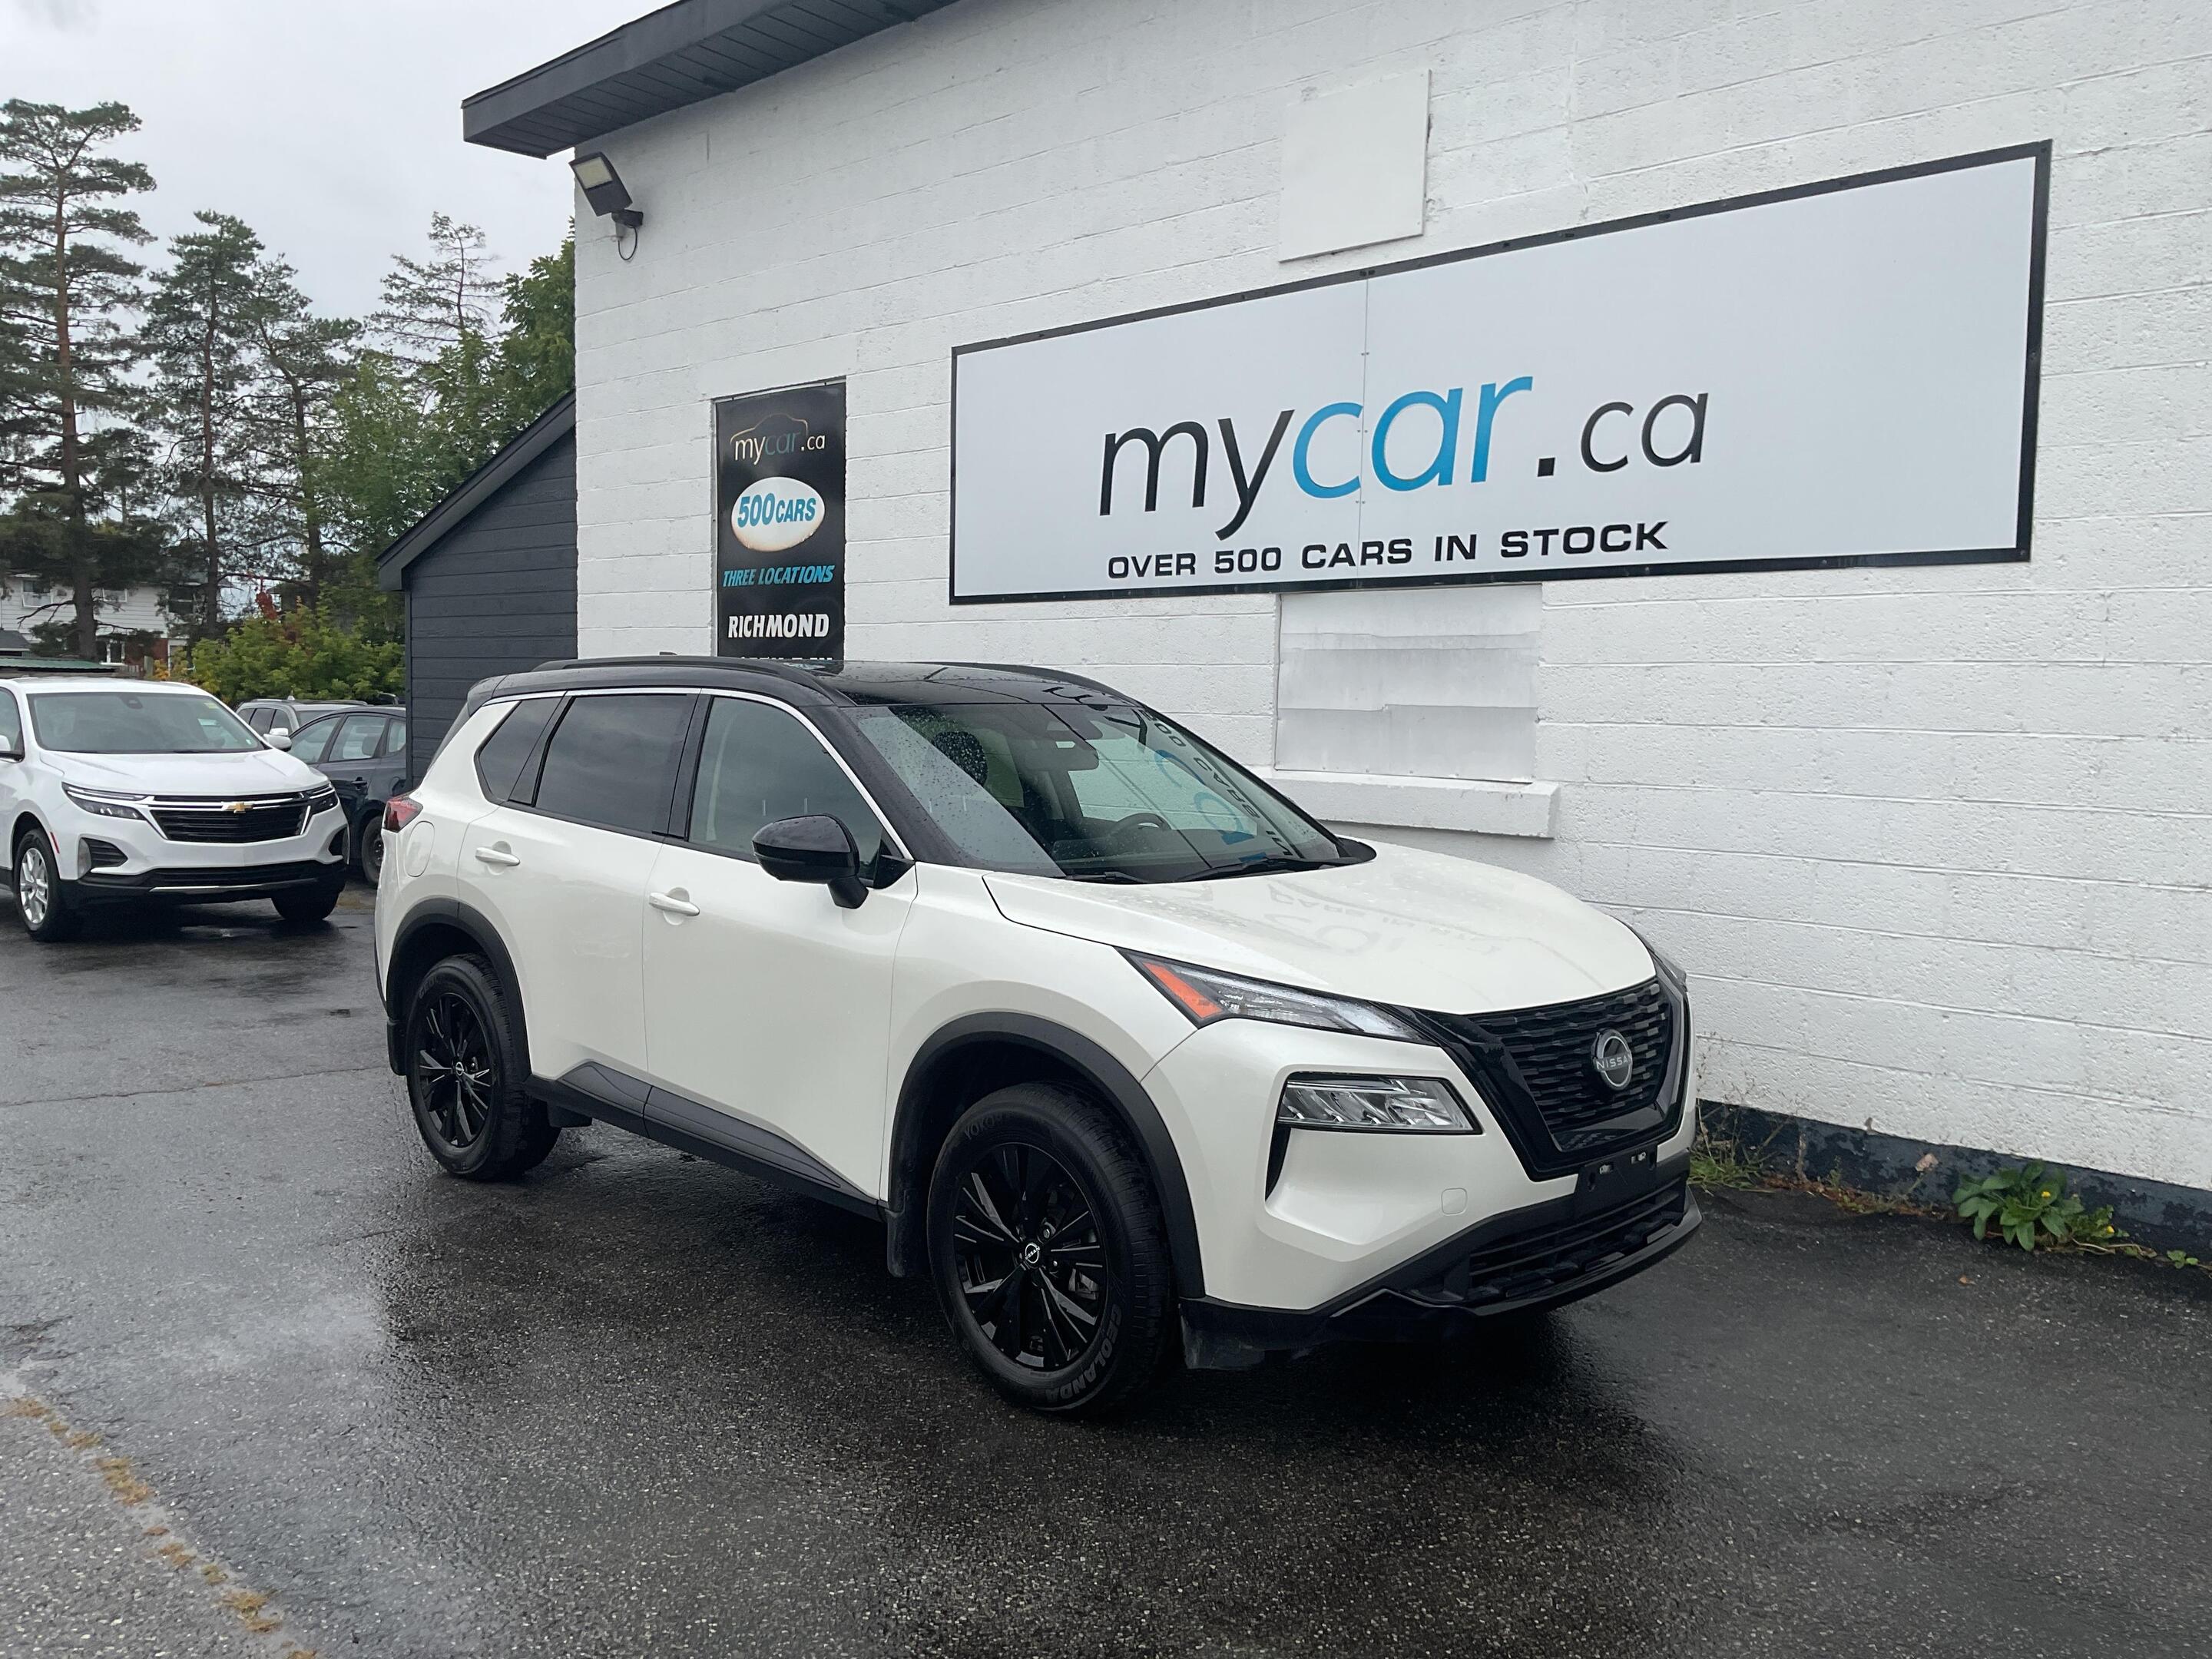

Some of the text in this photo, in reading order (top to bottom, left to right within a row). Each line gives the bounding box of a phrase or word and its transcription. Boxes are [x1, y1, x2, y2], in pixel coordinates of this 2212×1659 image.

[734, 432, 826, 465] mycar.ca
[1099, 376, 1709, 541] mycar.ca
[1108, 521, 1668, 580] OVER 500 CARS IN STOCK
[723, 565, 835, 587] THREE LOCATIONS
[728, 614, 830, 638] RICHMOND
